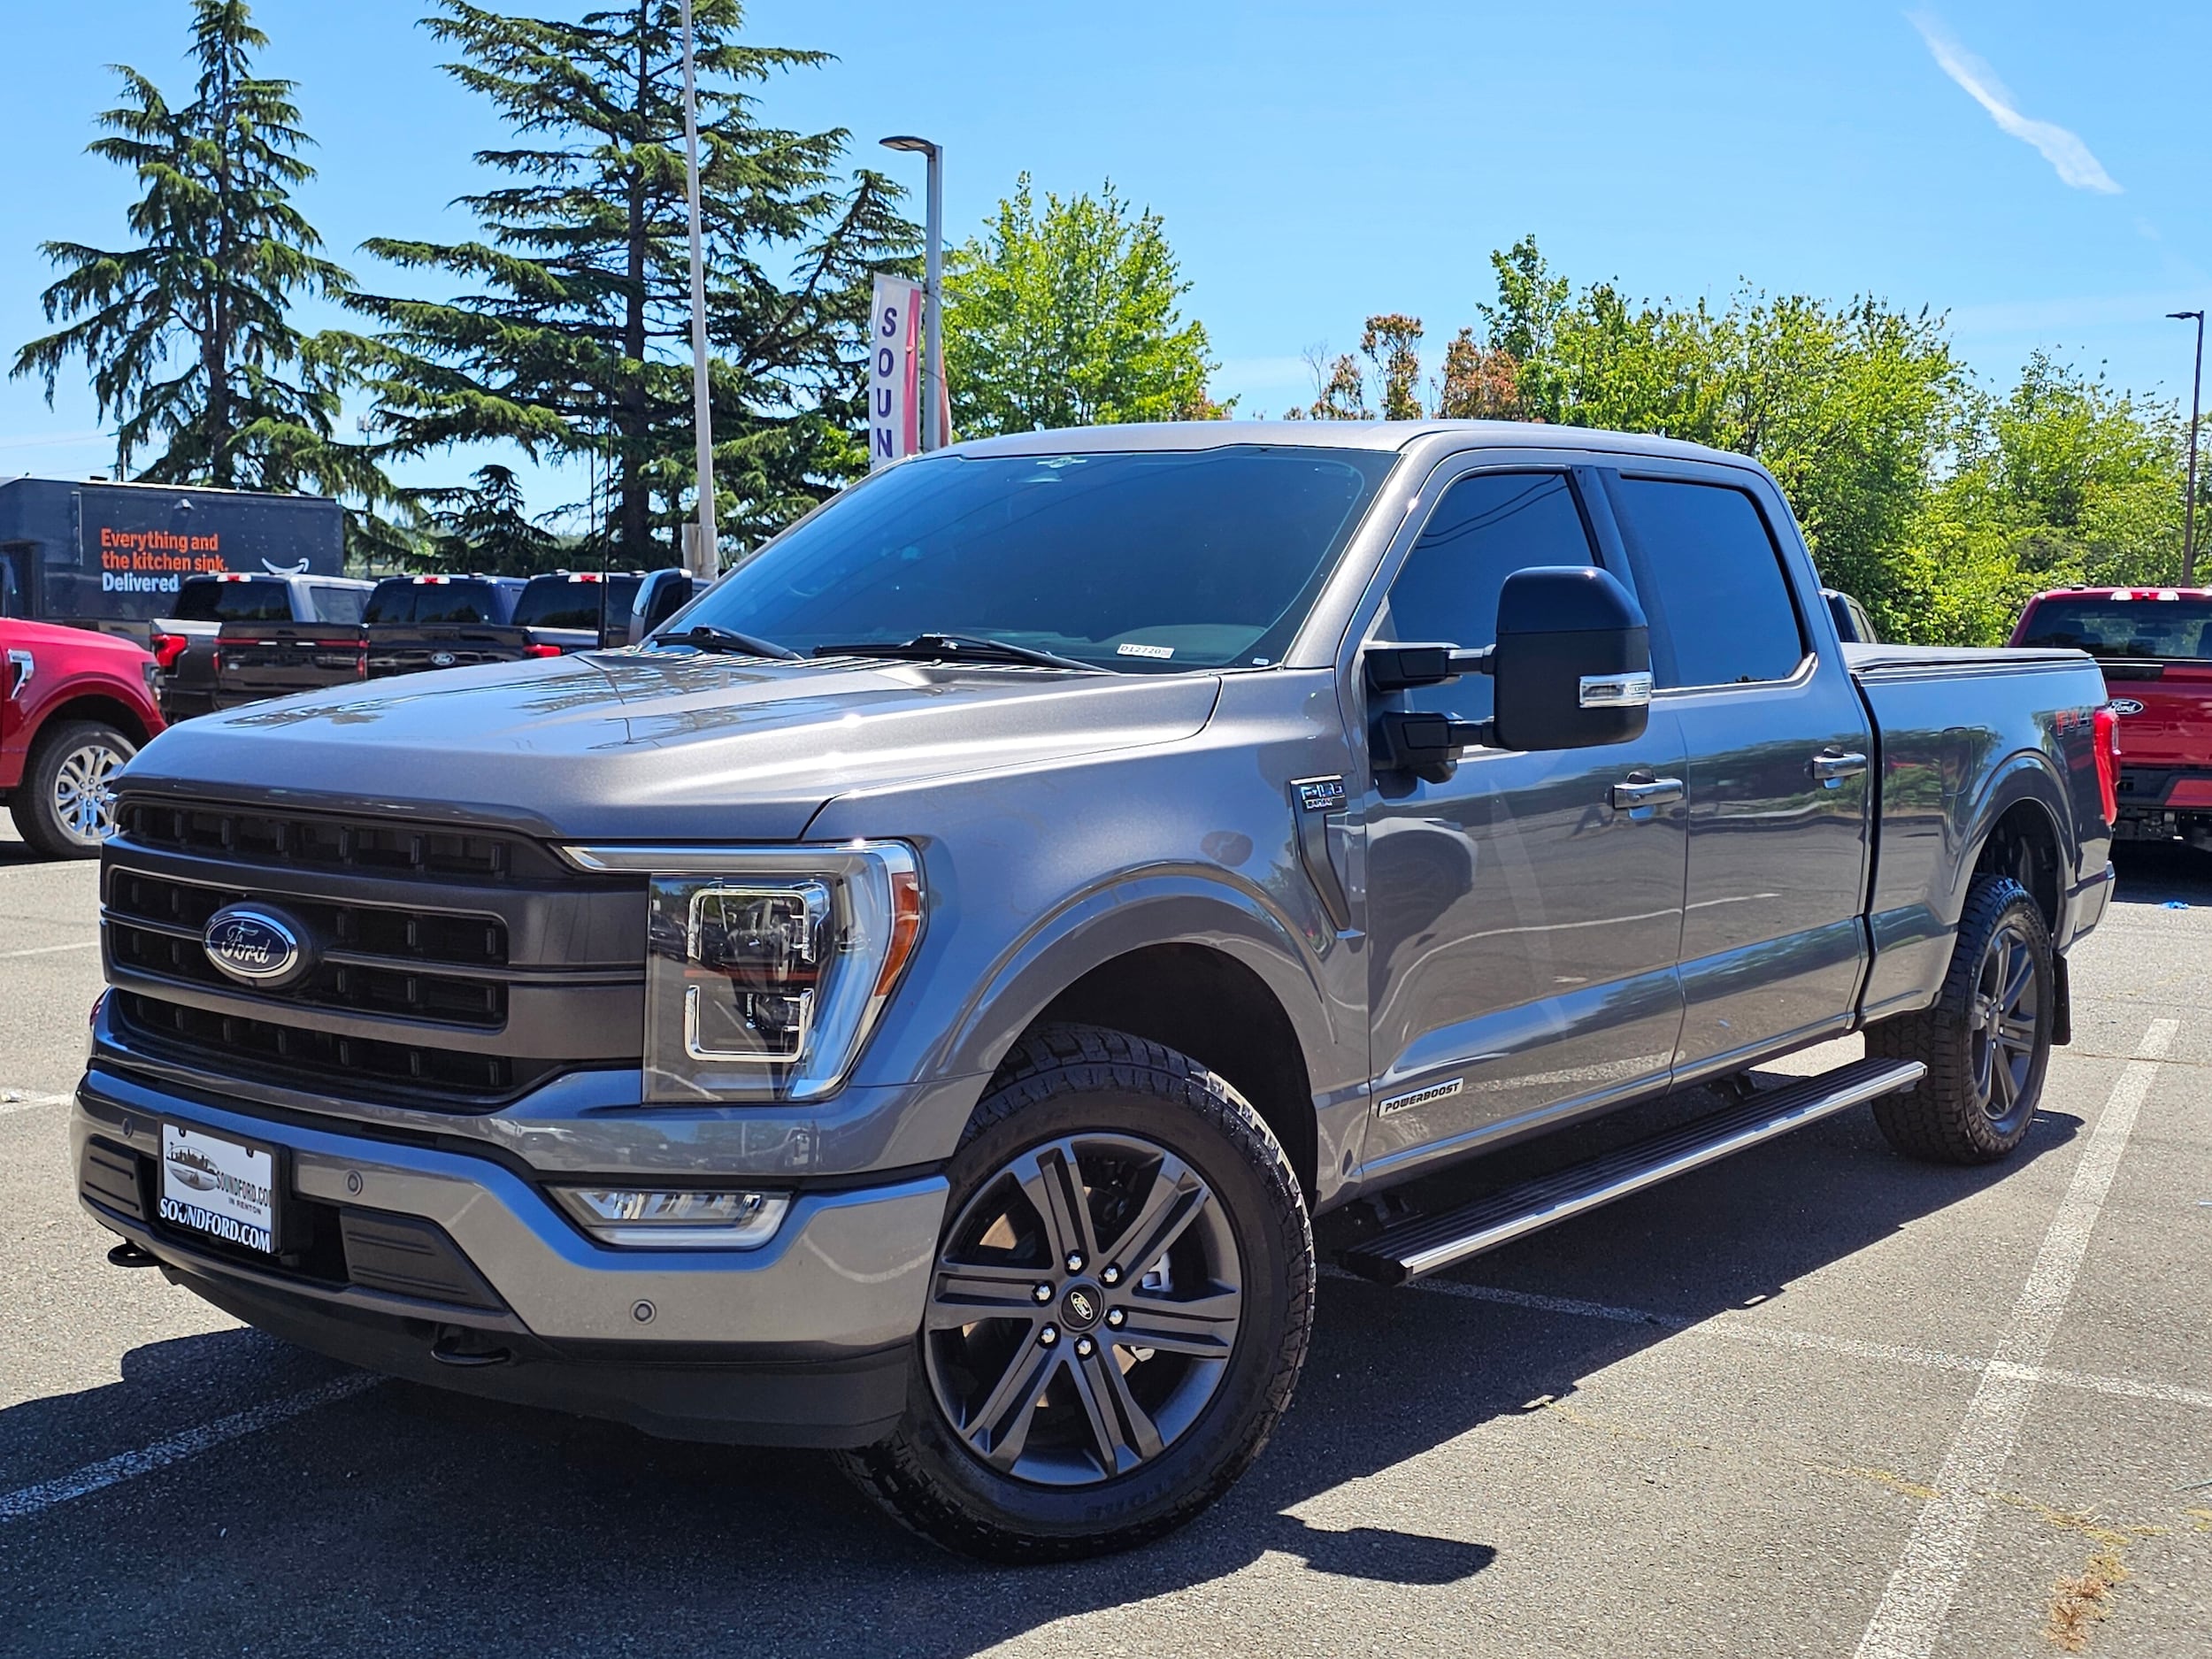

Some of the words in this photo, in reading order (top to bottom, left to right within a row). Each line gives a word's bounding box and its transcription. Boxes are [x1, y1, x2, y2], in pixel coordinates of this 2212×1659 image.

[876, 306, 898, 459] SOUN
[101, 527, 188, 553] Everything
[191, 534, 219, 550] and
[102, 550, 130, 570] the
[133, 551, 191, 571] kitchen
[194, 554, 229, 572] sink.
[2055, 709, 2093, 738] FX4
[221, 922, 271, 964] Ford
[1385, 1082, 1460, 1112] POWERBOOST
[236, 1199, 262, 1215] RENTON
[159, 1198, 271, 1254] SOUNDFORD.COM
